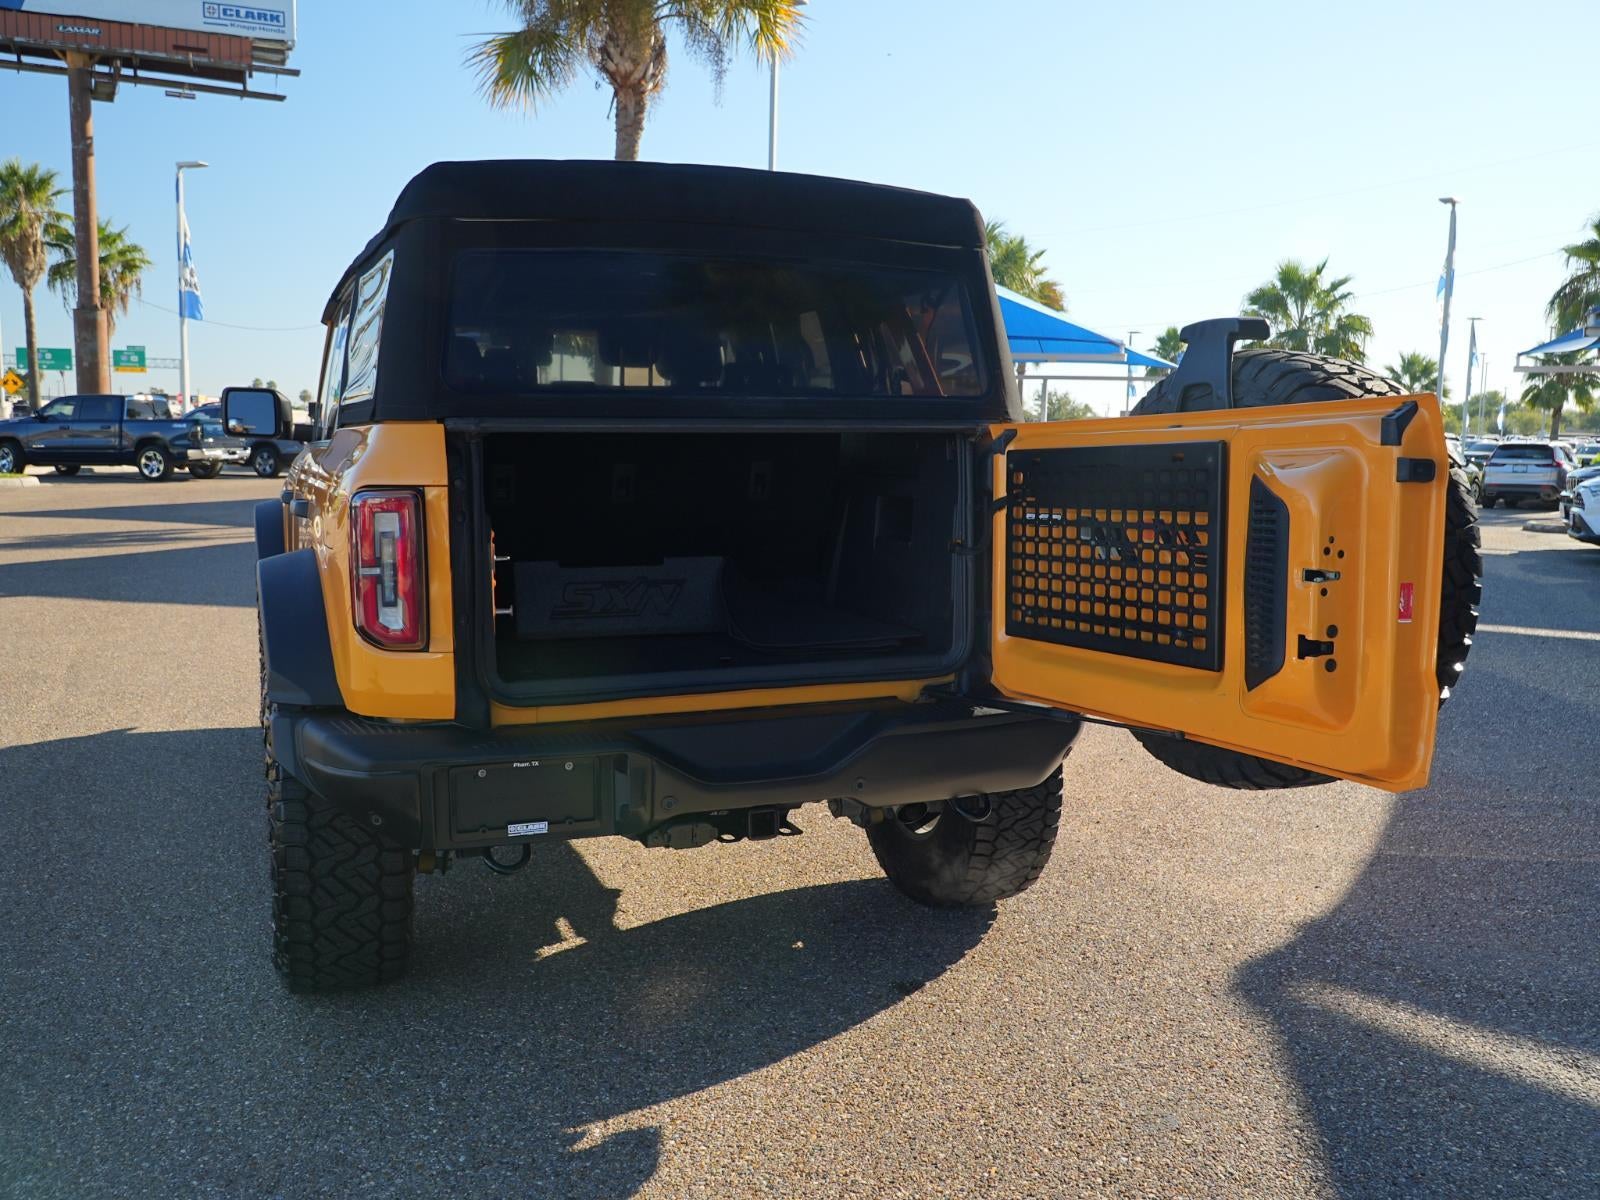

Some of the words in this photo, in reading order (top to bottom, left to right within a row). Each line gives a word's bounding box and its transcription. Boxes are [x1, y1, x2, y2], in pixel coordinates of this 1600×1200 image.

[222, 7, 281, 23] CLARK
[60, 25, 100, 35] LAMAR
[259, 25, 285, 33] Honda
